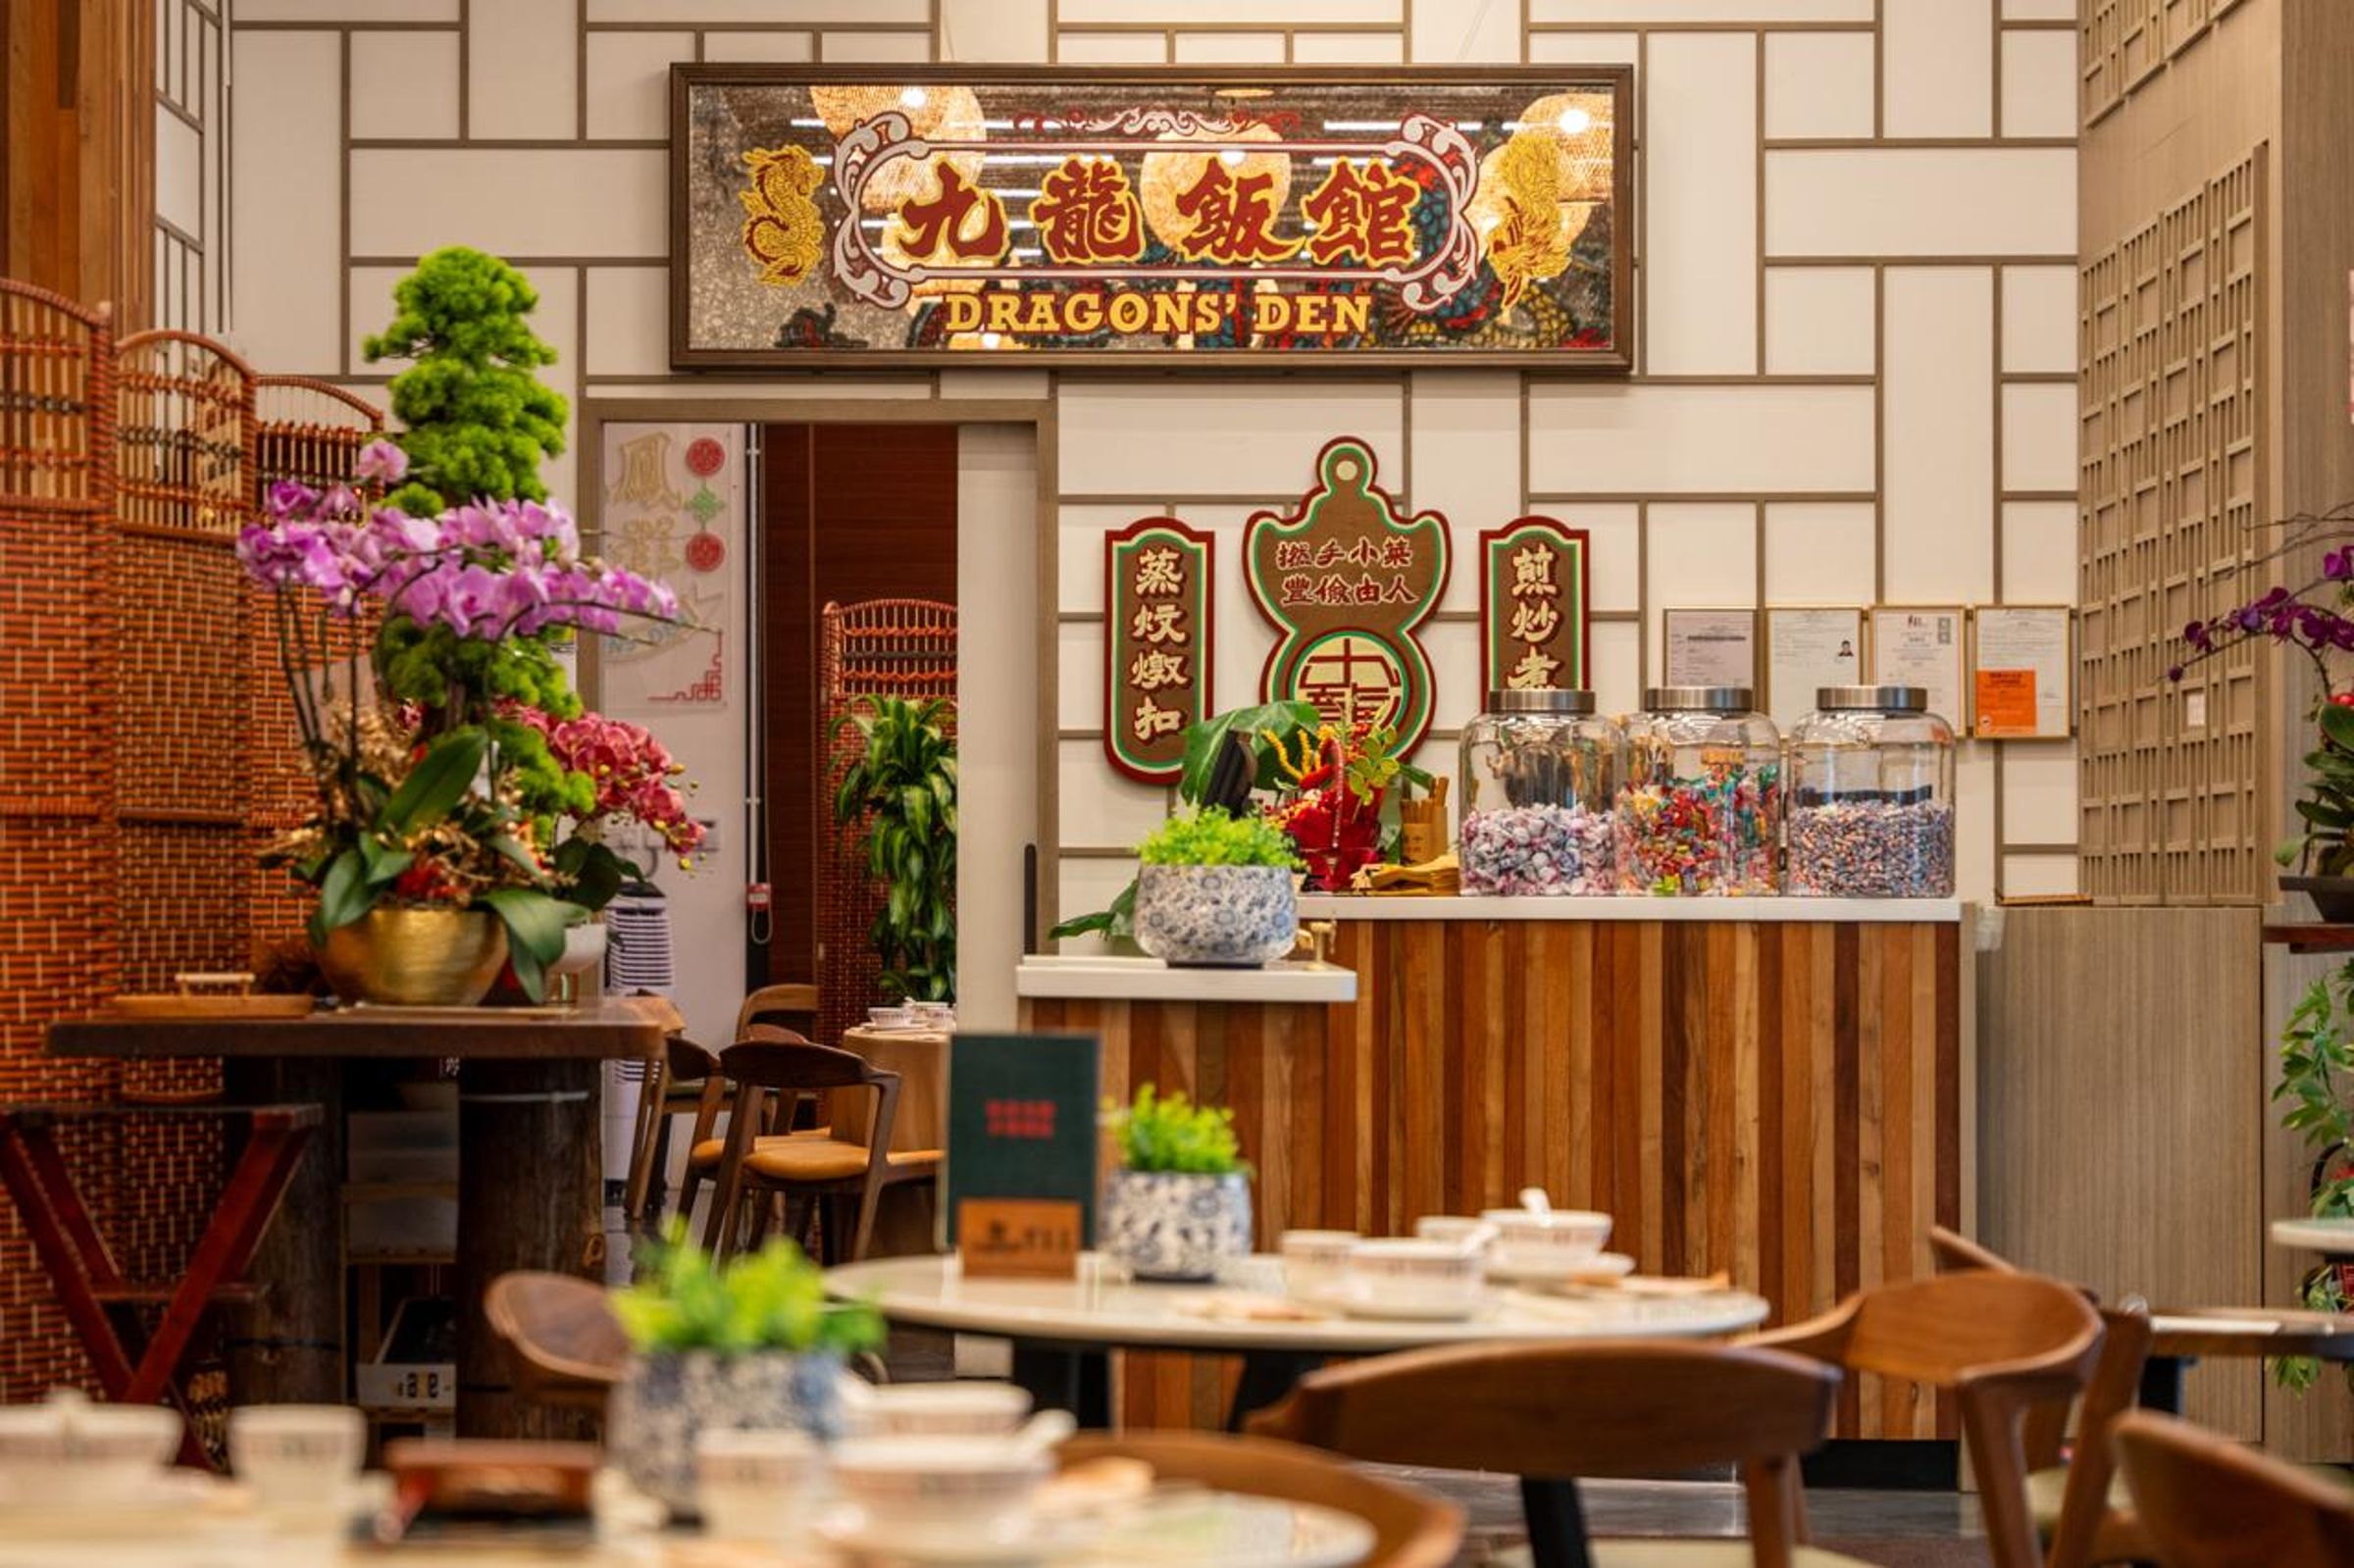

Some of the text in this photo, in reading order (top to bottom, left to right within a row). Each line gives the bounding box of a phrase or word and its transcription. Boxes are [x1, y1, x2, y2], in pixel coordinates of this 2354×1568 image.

[898, 156, 1420, 266] 九龍飯館
[944, 292, 1371, 332] DRAGONS' DEN
